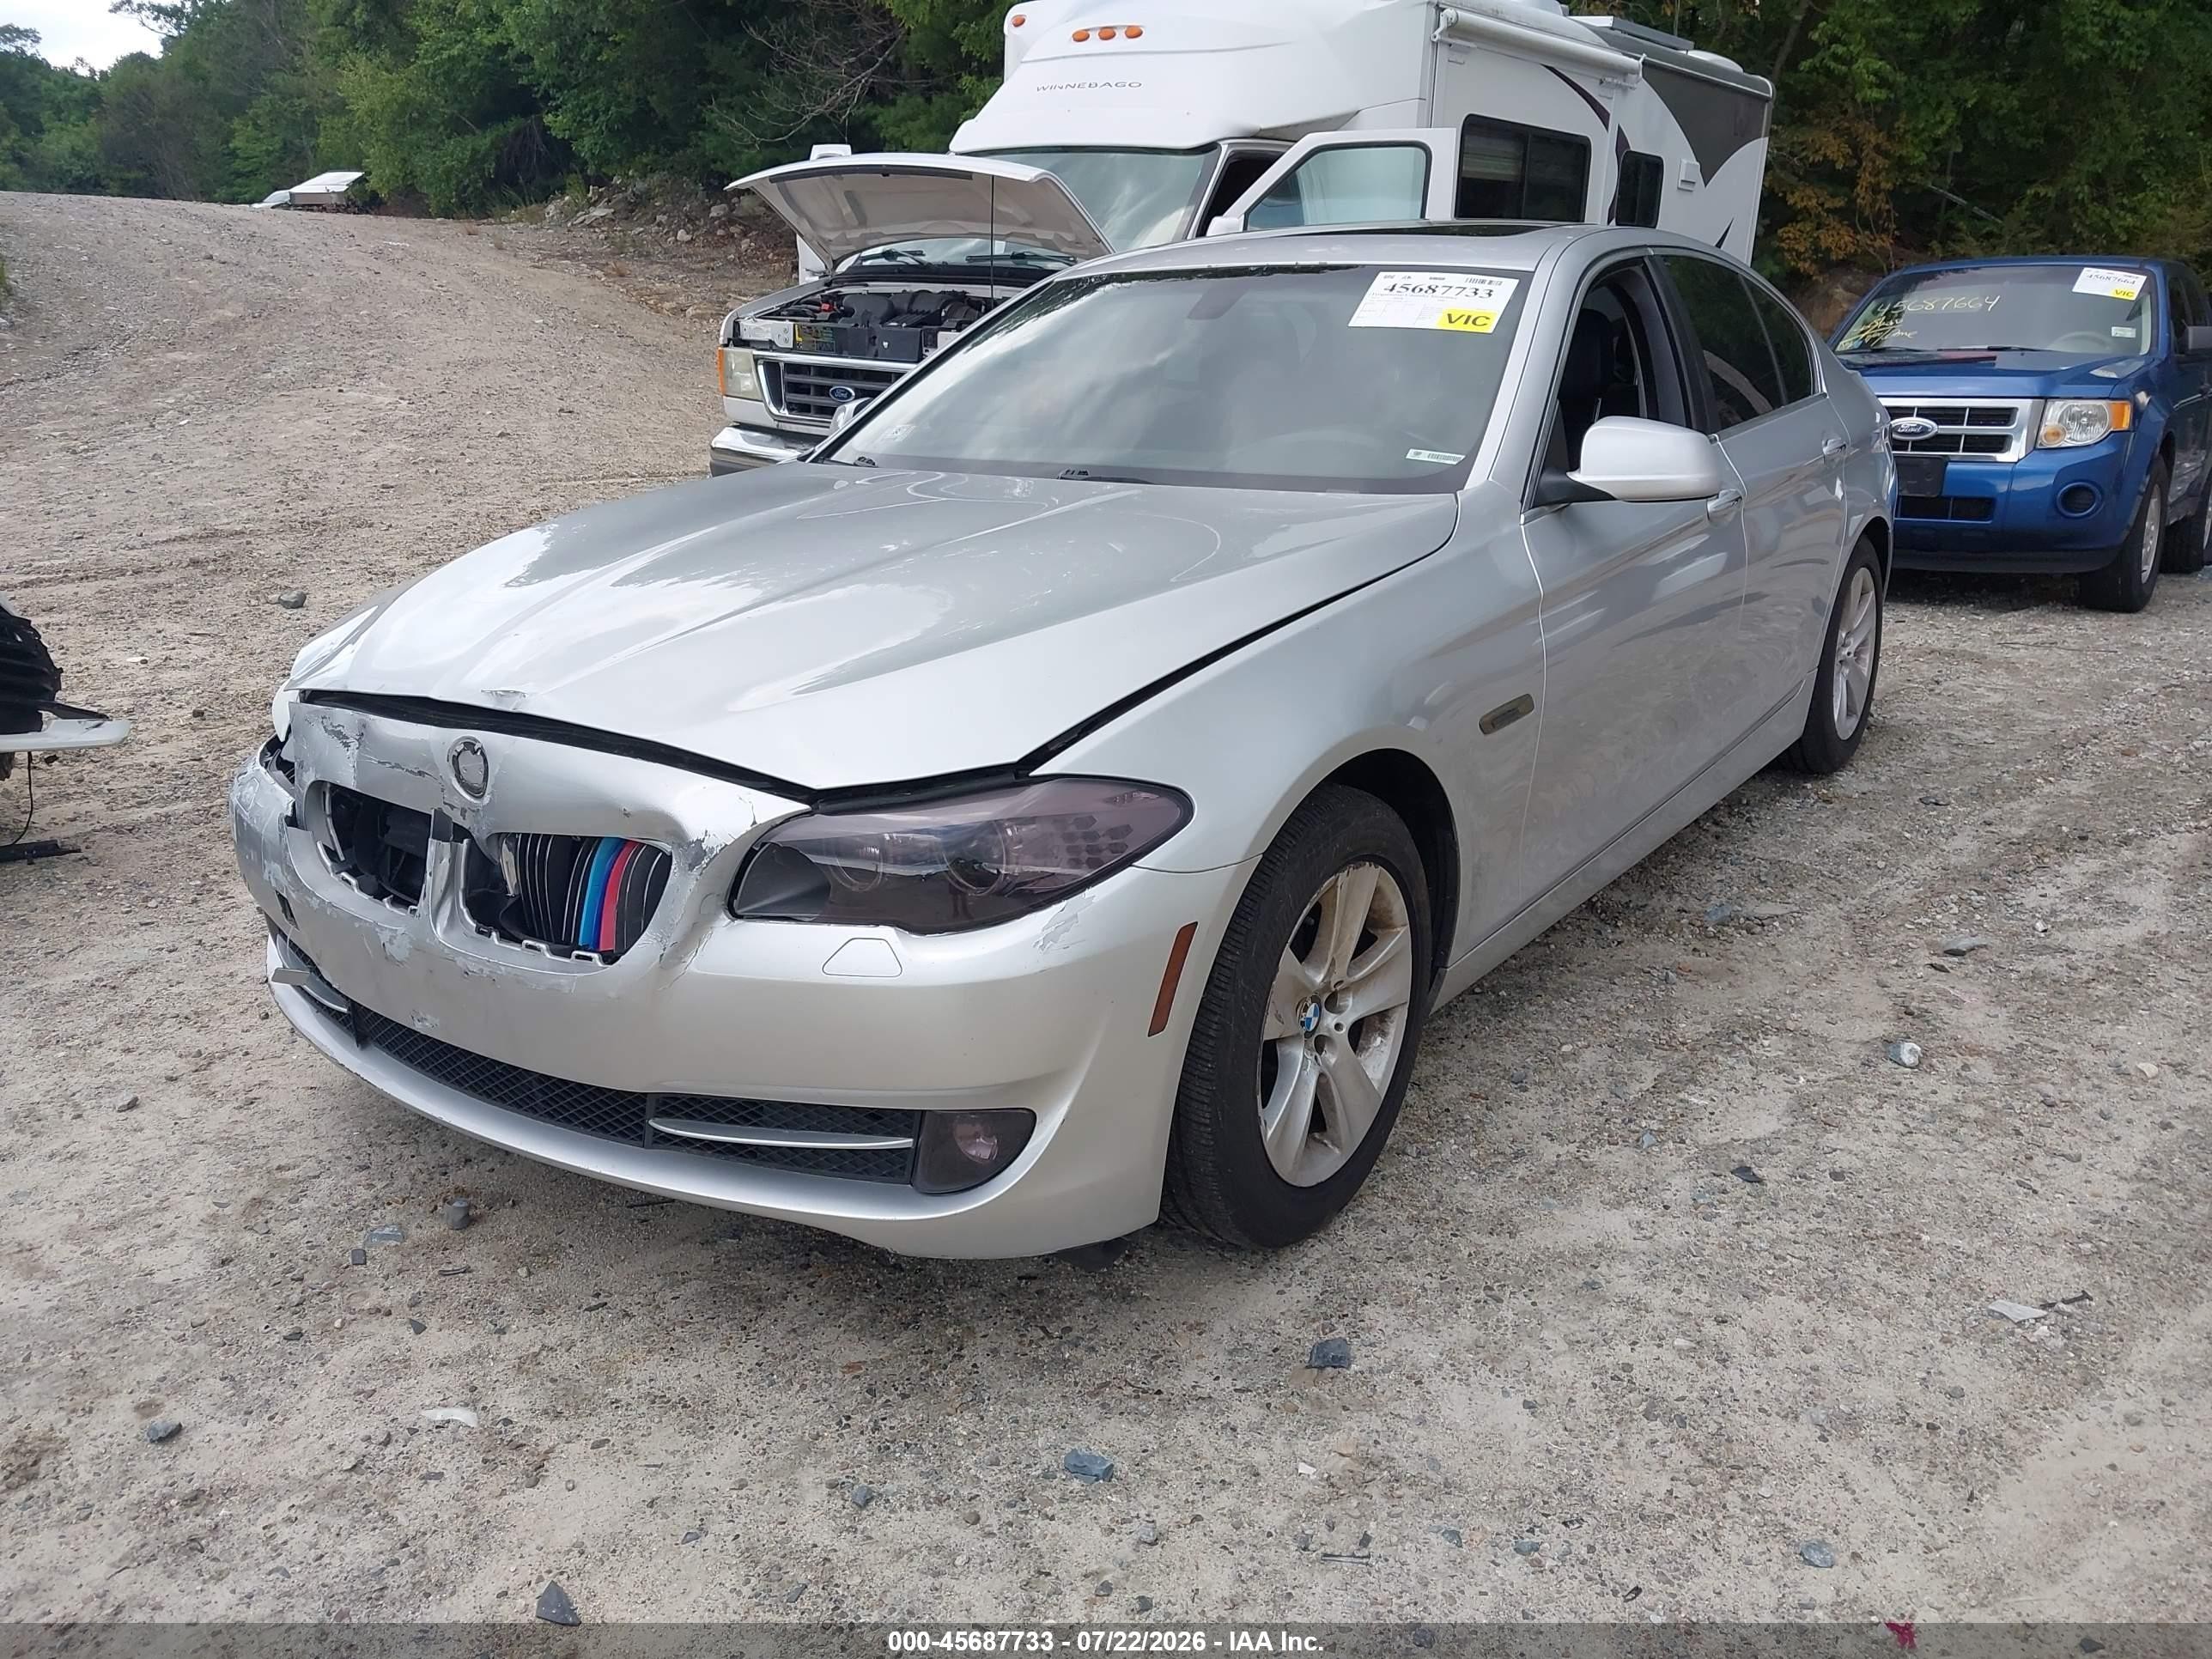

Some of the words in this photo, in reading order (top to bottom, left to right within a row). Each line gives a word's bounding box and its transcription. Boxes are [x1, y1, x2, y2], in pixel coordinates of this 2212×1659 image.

[1036, 82, 1142, 91] WINNEBAGO
[1383, 283, 1494, 299] 45687733
[2115, 289, 2134, 297] VIC
[1877, 295, 2000, 317] 45687664
[1446, 313, 1491, 326] VIC
[1898, 423, 1923, 434] Ford
